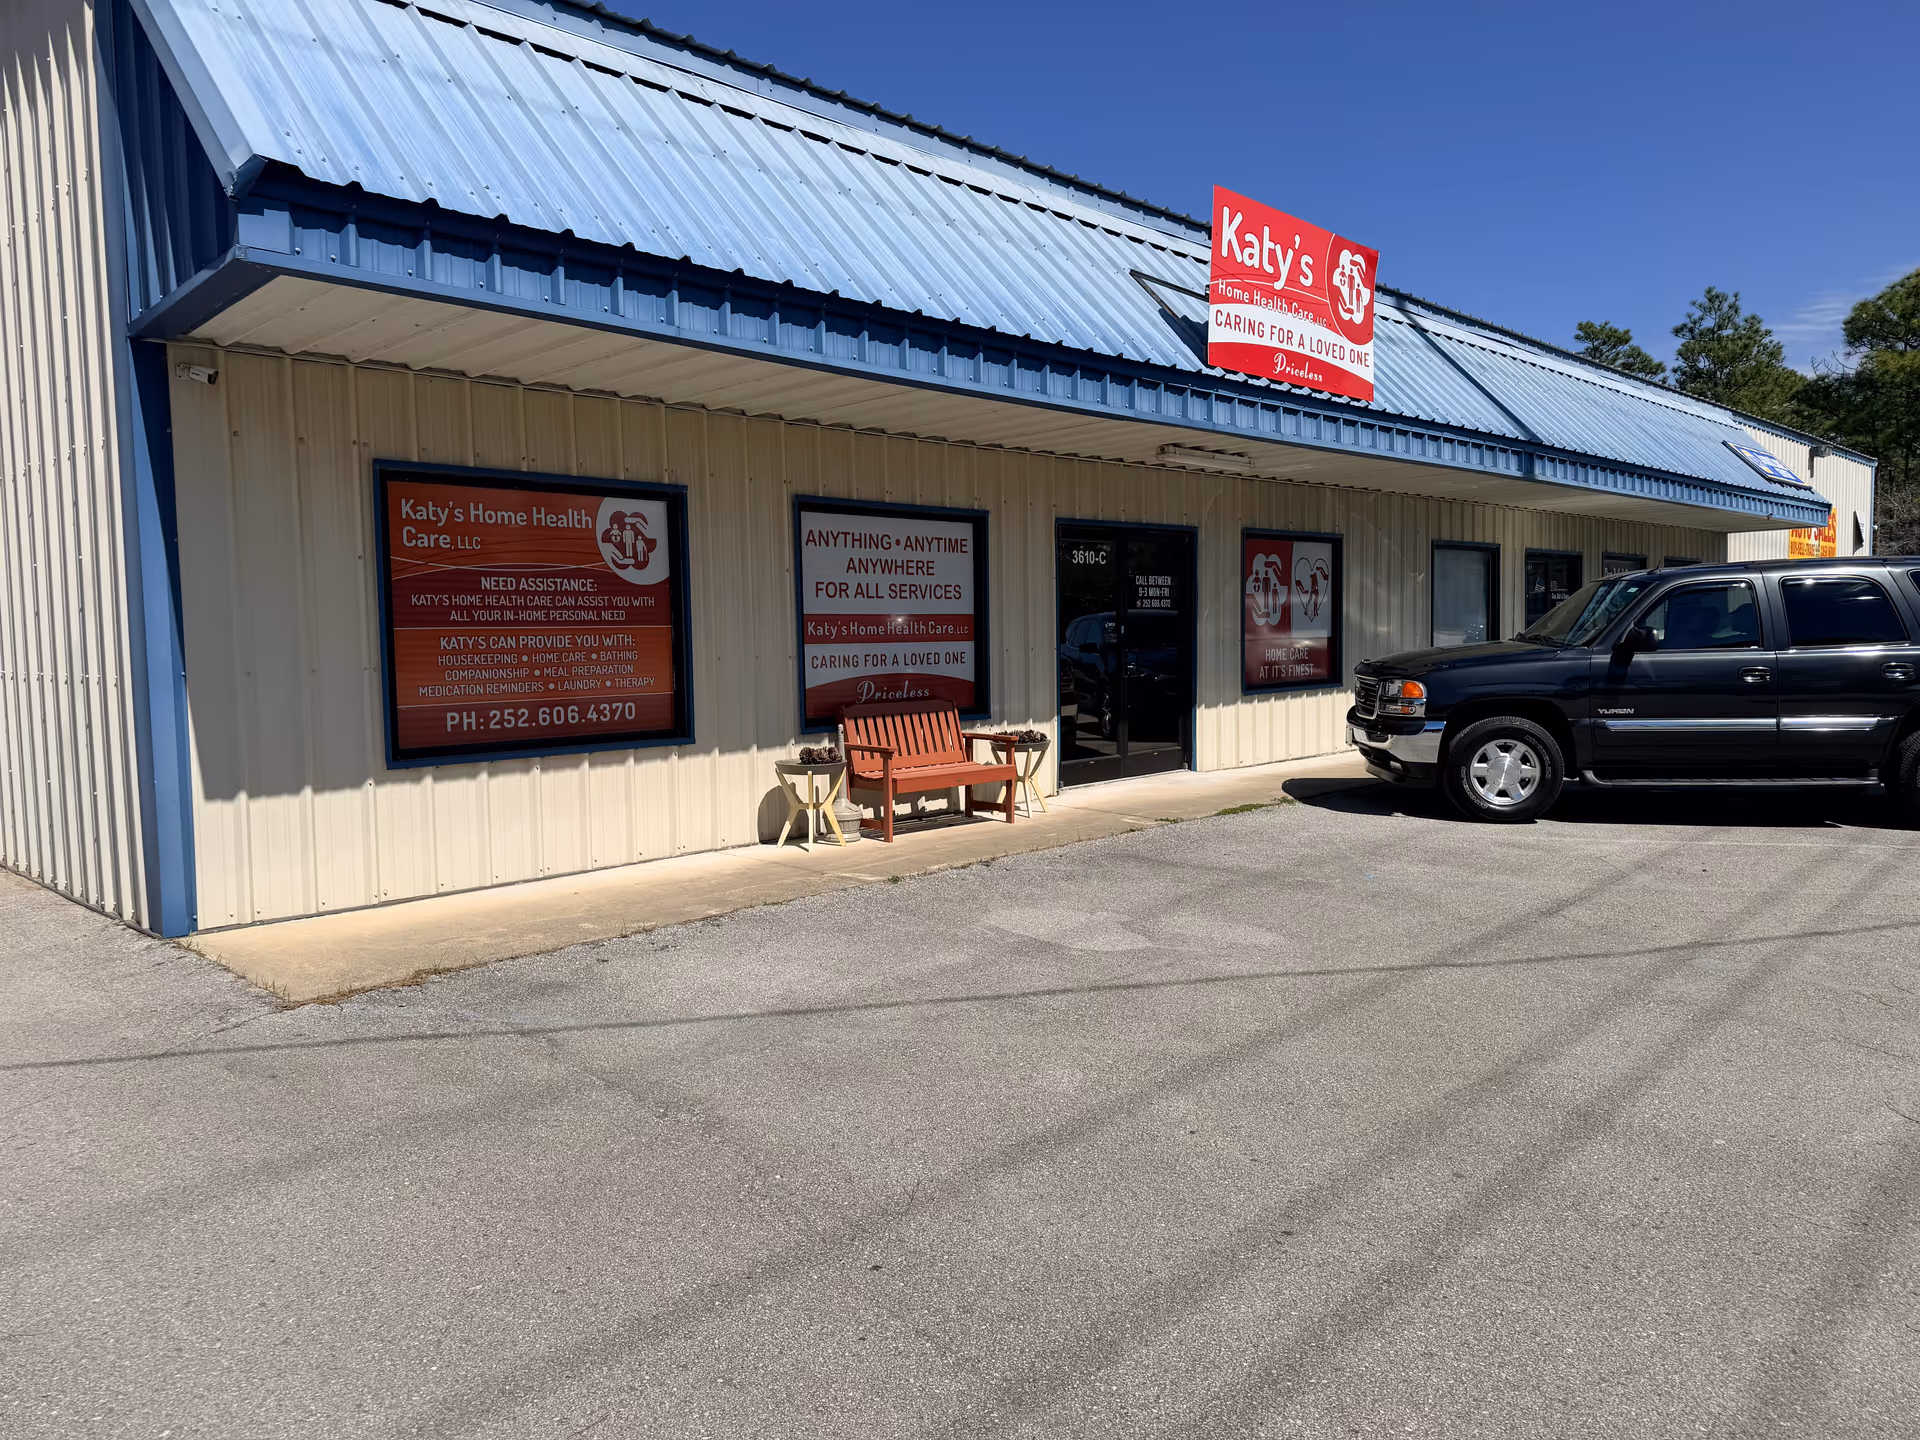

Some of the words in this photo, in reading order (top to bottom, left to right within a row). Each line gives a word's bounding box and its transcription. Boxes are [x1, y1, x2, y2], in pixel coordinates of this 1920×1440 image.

[1221, 206, 1314, 290] Katy's
[1219, 278, 1249, 303] Home
[1253, 290, 1288, 315] Health
[1317, 316, 1327, 327] LLC
[1215, 309, 1264, 338] CARING
[1270, 325, 1294, 347] FOR
[1298, 333, 1305, 350] A
[1309, 338, 1345, 361] LOVED
[1350, 348, 1370, 368] ONE
[1272, 352, 1323, 382] Priceless
[401, 498, 464, 527] Katy's
[470, 502, 527, 526] Home
[532, 506, 592, 529] Health
[402, 526, 455, 550] Care,
[457, 536, 481, 549] LLC
[805, 528, 892, 551] ANYTHING
[904, 535, 968, 554] ANYTIME
[846, 557, 935, 576] ANYWHERE
[1072, 550, 1107, 564] 3610-C
[480, 576, 516, 591] NEED
[519, 577, 598, 592] ASSISTANCE:
[1136, 575, 1148, 585] CALL
[1149, 576, 1172, 585] BETWEEN
[815, 581, 849, 599] FOR
[854, 582, 884, 599] ALL
[888, 583, 962, 600] SERVICES
[1139, 587, 1147, 596] 9-3
[1149, 587, 1170, 596] MON-FRI
[411, 594, 449, 606] KATY'S
[452, 595, 483, 606] HOME
[485, 595, 525, 606] HEALTH
[527, 595, 553, 607] CARE
[555, 595, 575, 607] CAN
[577, 596, 609, 607] ASSIST
[610, 596, 630, 607] YOU
[631, 596, 655, 607] WITH
[450, 610, 470, 621] ALL
[472, 610, 501, 621] YOUR
[503, 610, 548, 621] IN-HOME
[550, 610, 600, 621] PERSONAL
[601, 610, 626, 621] NEED
[808, 620, 848, 639] Katy's
[850, 621, 885, 635] Home
[887, 621, 926, 635] Health
[440, 636, 487, 650] KATY'S
[489, 636, 516, 649] CAN
[520, 635, 573, 649] PROVIDE
[575, 634, 599, 647] YOU
[602, 634, 635, 647] WITH:
[438, 653, 518, 666] HOUSEKEEPING
[532, 653, 560, 663] HOME
[562, 651, 587, 662] CARE
[600, 650, 638, 661] BATHING
[811, 655, 859, 669] CARING
[864, 654, 887, 667] FOR
[892, 653, 899, 666] A
[904, 652, 940, 666] LOVED
[945, 651, 966, 664] ONE
[1265, 648, 1287, 661] HOME
[1289, 647, 1309, 660] CARE
[445, 667, 529, 681] COMPANIONSHIP
[543, 666, 570, 677] MEAL
[572, 664, 634, 676] PREPARATION
[1259, 665, 1269, 678] AT
[1272, 664, 1286, 677] IT'S
[1288, 664, 1314, 676] FINEST
[419, 684, 484, 697] MEDICATION
[486, 681, 545, 694] REMINDERS
[558, 679, 602, 691] LAUNDRY
[615, 677, 655, 688] THERAPY
[856, 680, 930, 704] Priceless
[446, 711, 484, 732] PH:
[489, 702, 636, 729] 252.606.4370
